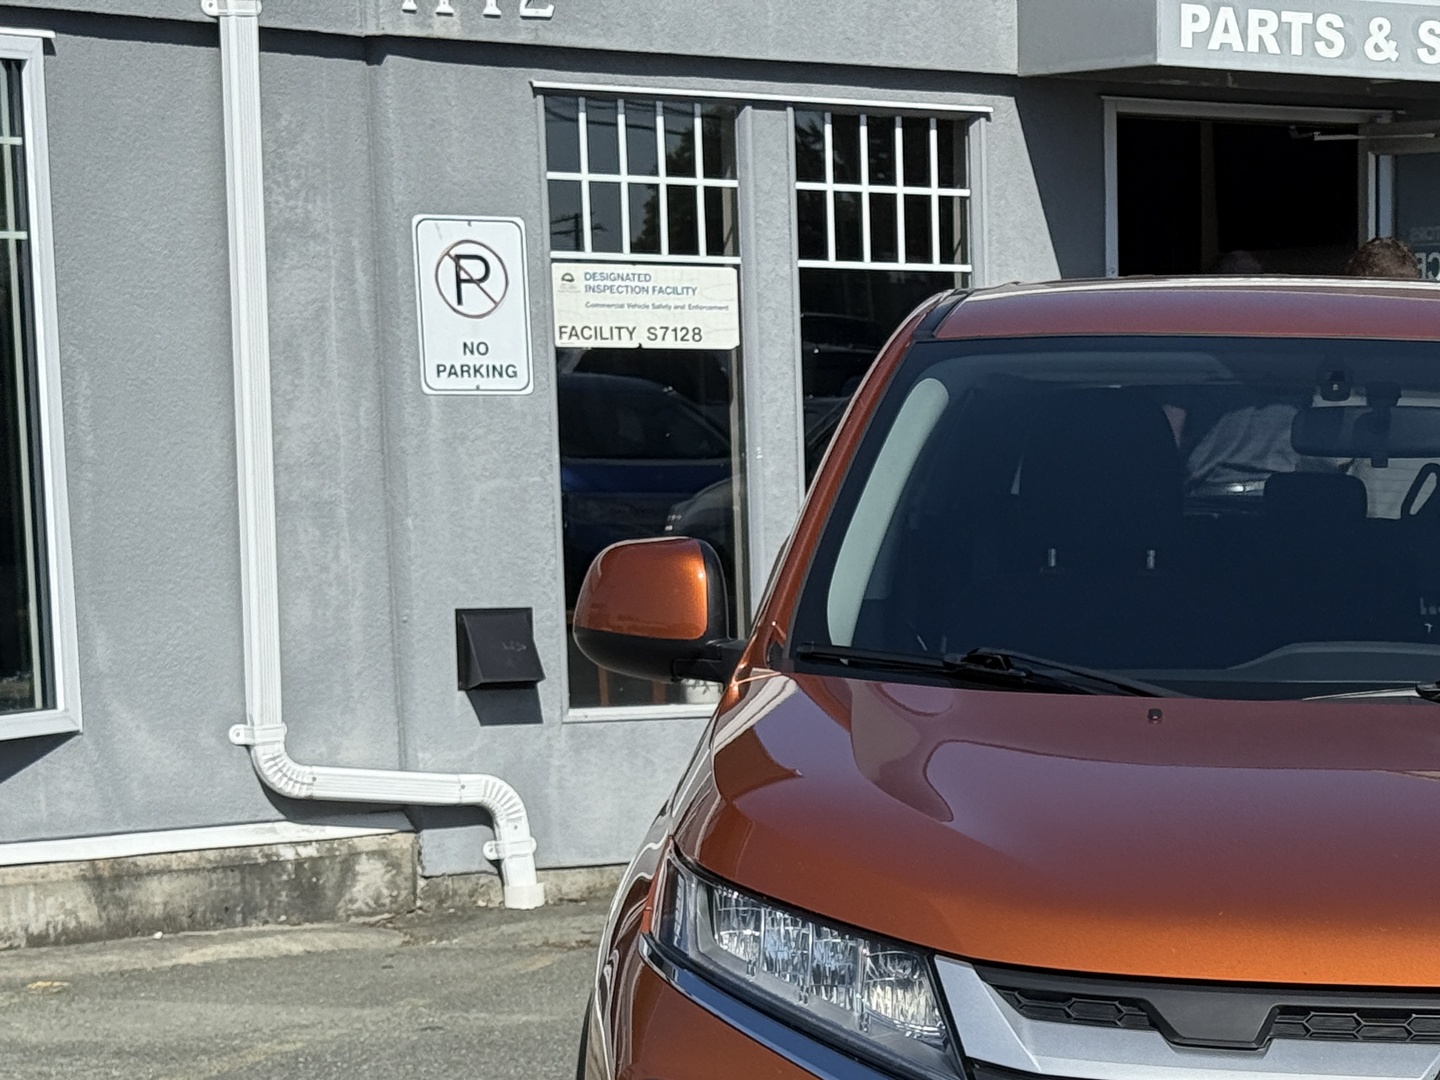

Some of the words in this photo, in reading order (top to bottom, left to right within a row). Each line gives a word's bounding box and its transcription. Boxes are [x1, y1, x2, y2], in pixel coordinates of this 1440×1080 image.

[1179, 3, 1345, 59] PARTS
[1363, 16, 1399, 63] &
[584, 271, 652, 282] DESIGNATED
[584, 284, 649, 295] INSPECTION
[652, 285, 698, 296] FACILITY
[558, 325, 637, 341] FACILITY
[646, 326, 703, 342] S7128
[463, 341, 489, 356] NO
[436, 363, 518, 379] PARKING
